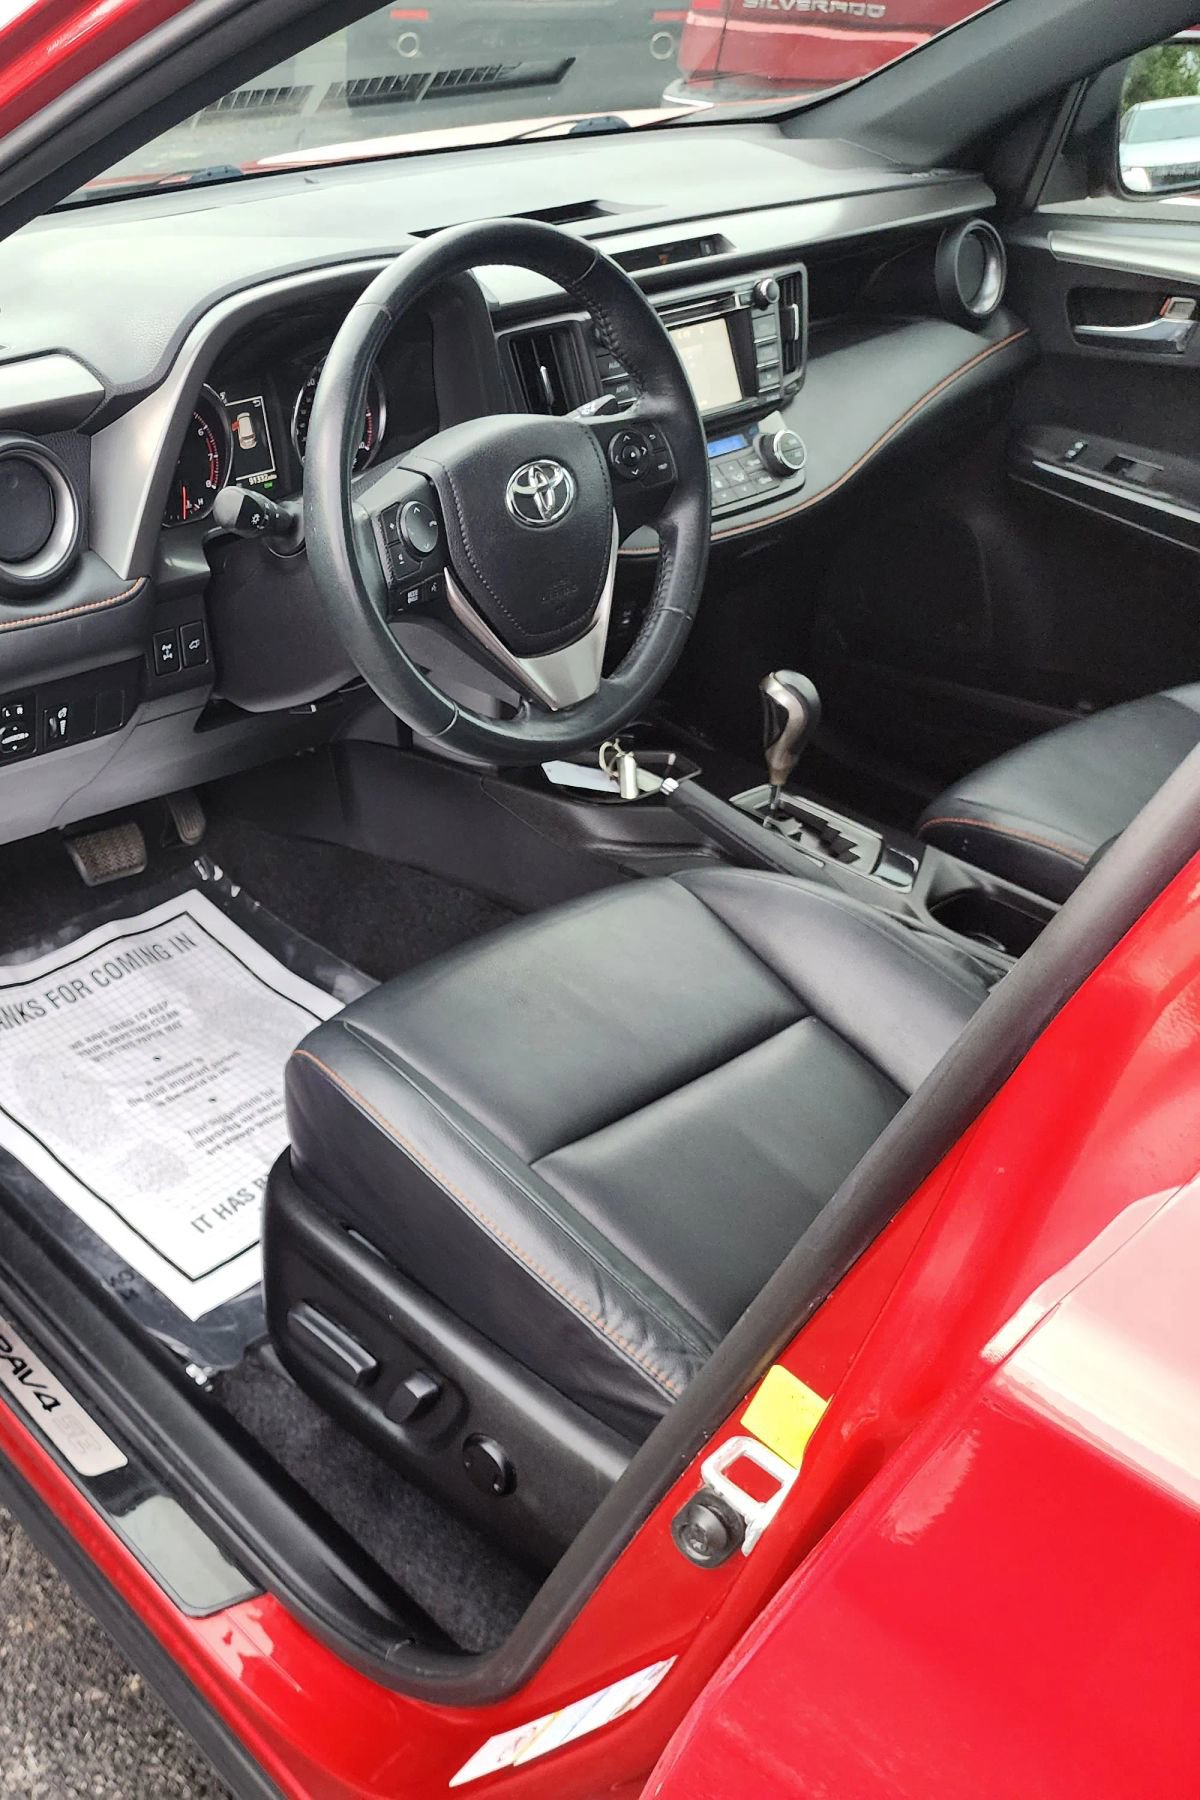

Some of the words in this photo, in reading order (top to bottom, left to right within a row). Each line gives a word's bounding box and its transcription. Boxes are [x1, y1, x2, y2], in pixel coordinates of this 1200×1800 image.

[742, 0, 886, 18] SILVERADO
[197, 428, 204, 436] 6
[207, 453, 214, 461] 7
[205, 480, 212, 488] 8
[44, 978, 93, 1010] FOR
[90, 943, 172, 988] COMING
[168, 932, 198, 955] IN
[190, 1214, 213, 1234] IT
[211, 1187, 256, 1220] HAS
